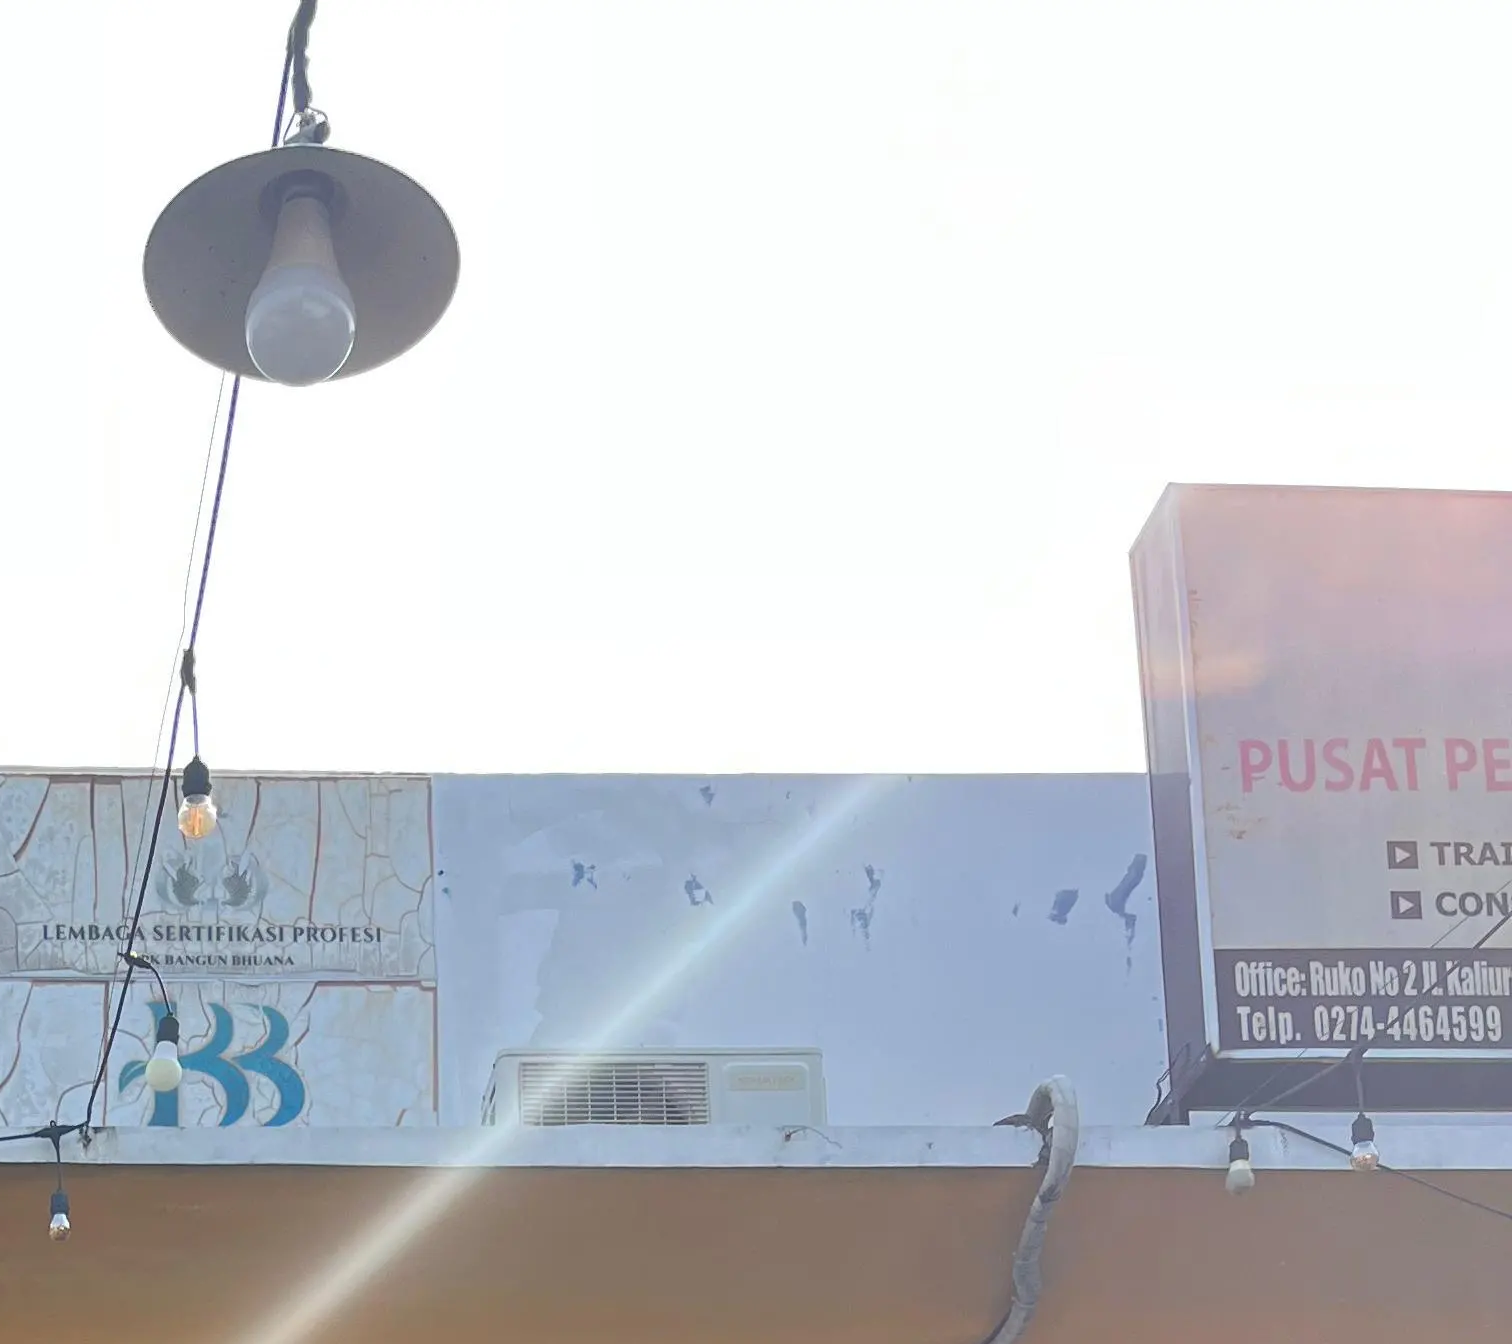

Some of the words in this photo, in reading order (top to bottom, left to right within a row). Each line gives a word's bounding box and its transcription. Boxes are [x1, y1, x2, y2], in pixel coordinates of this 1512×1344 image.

[1238, 737, 1427, 793] PUSAT
[1444, 737, 1512, 792] PE
[1435, 891, 1512, 917] CON
[42, 924, 145, 941] LEMBAGA
[153, 925, 285, 943] SERTIFIKASI
[292, 926, 382, 943] PROFESI
[165, 955, 228, 966] BANGUN
[232, 955, 295, 966] BHUANA
[1234, 961, 1306, 997] Office:
[1309, 961, 1366, 997] Ruko
[1370, 961, 1399, 996] No
[1403, 960, 1418, 996] 2
[1237, 1006, 1301, 1044] Telp.
[1314, 1005, 1502, 1042] 0274-4464599
